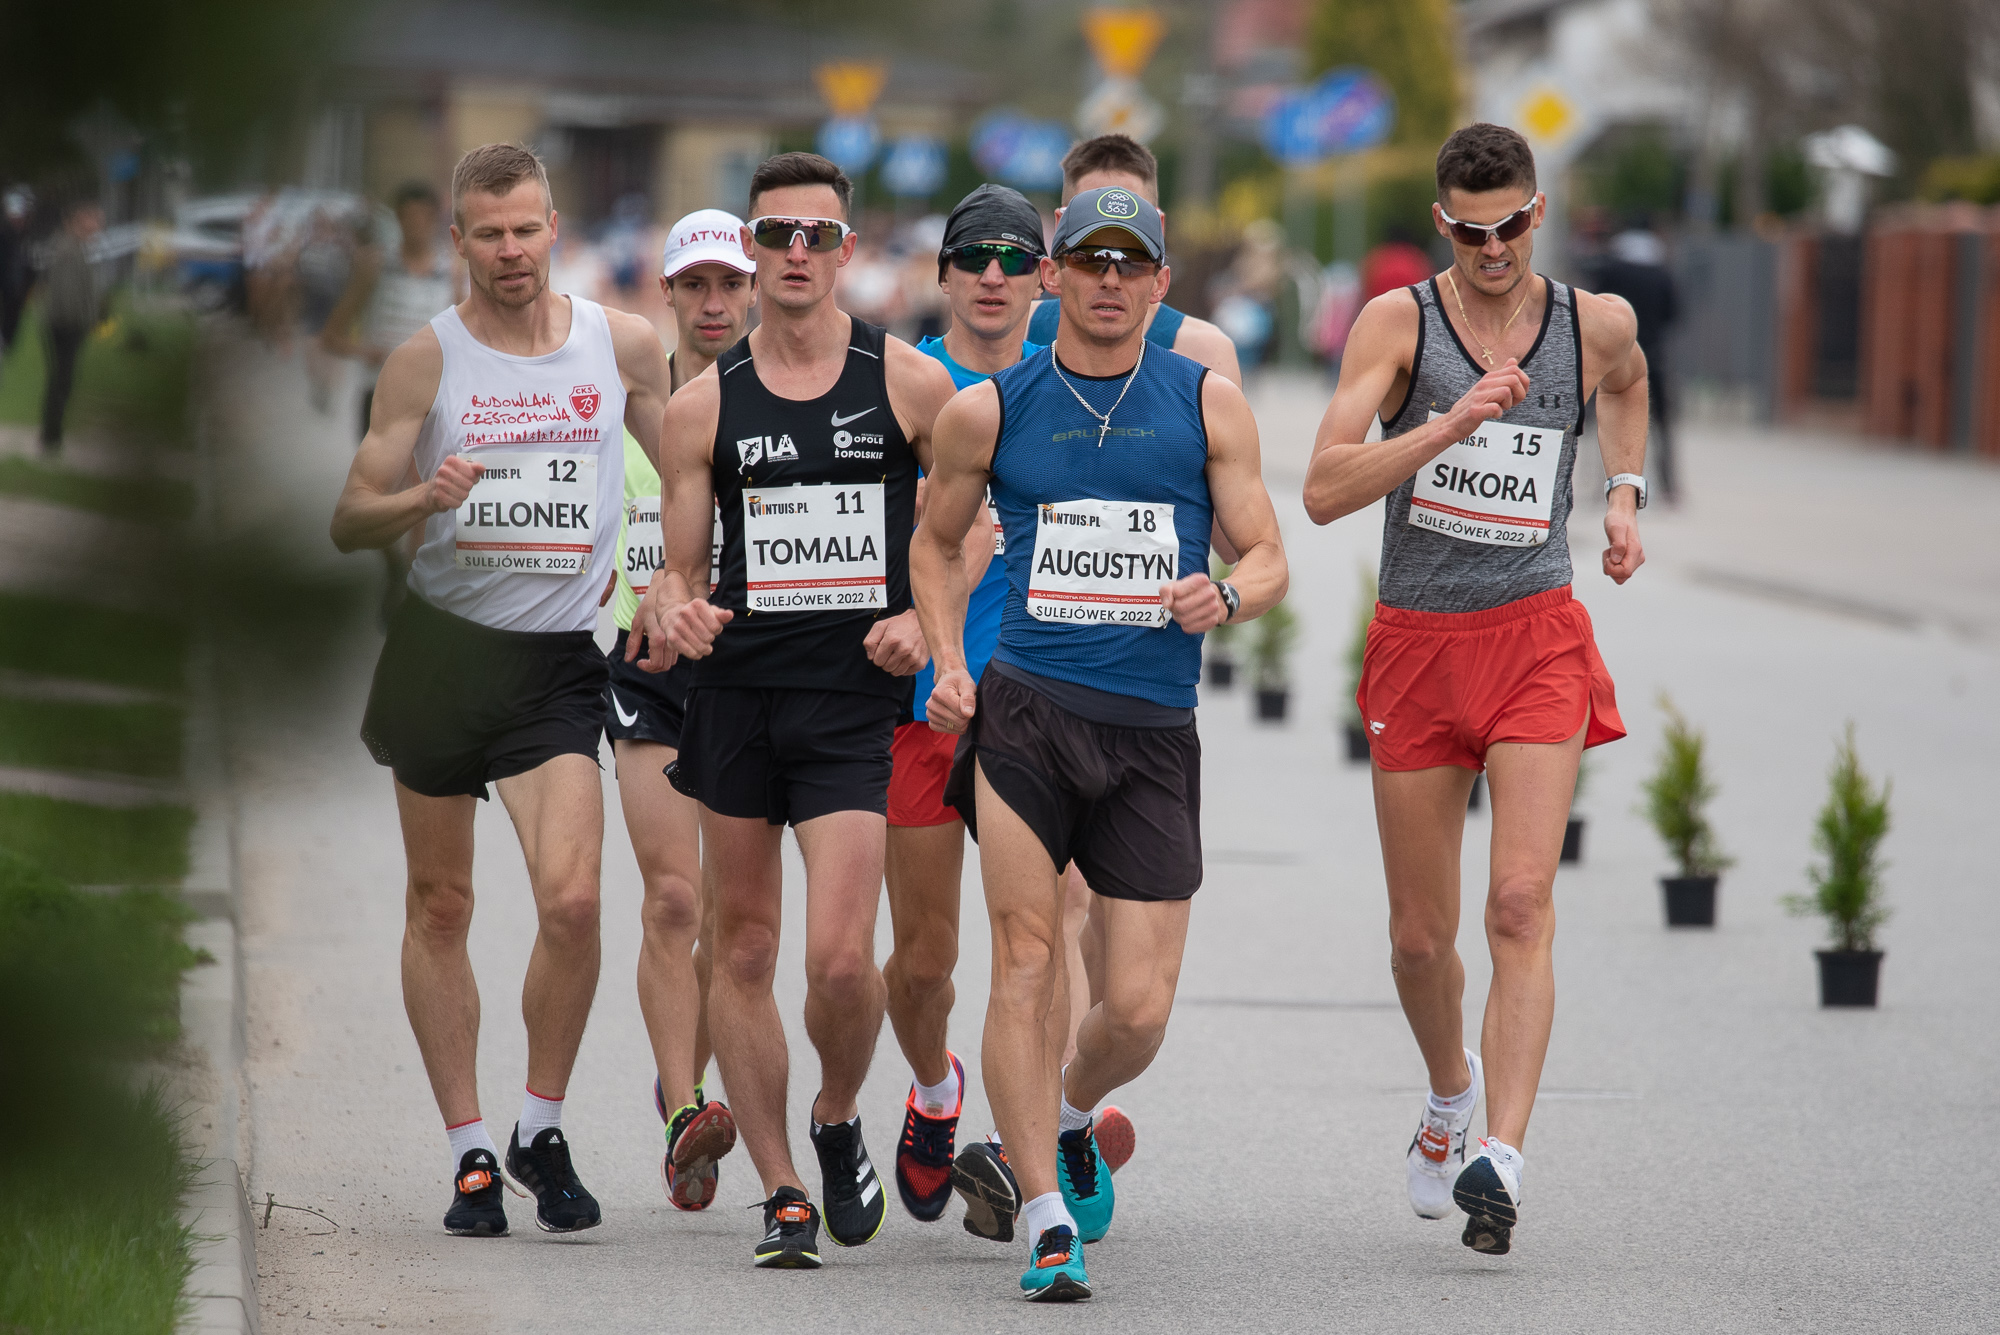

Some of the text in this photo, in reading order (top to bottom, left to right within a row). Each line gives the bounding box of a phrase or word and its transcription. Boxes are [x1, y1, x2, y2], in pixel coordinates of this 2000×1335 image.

[1105, 206, 1128, 215] 365
[680, 230, 737, 247] LATVIA
[853, 436, 884, 445] OPOLE
[1458, 436, 1488, 448] UIS.PL
[1512, 432, 1542, 456] 15
[840, 450, 884, 460] OPOLSKIE
[547, 459, 577, 482] 12
[1432, 463, 1537, 503] SIKORA
[762, 502, 809, 515] INTUIS.PL
[834, 490, 864, 515] 11
[464, 502, 590, 529] JELONEK
[636, 511, 661, 524] INTUI
[1053, 512, 1100, 527] INTUIS.PL
[1128, 509, 1157, 533] 18
[1416, 513, 1525, 543] SULEJÓWEK 2022
[753, 535, 878, 566] TOMALA
[464, 555, 576, 569] SULEJÓWEK 2022
[1037, 547, 1173, 580] AUGUSTYN
[756, 592, 864, 607] SULEJÓWEK 2022
[1036, 606, 1152, 622] SULEJÓWEK 2022
